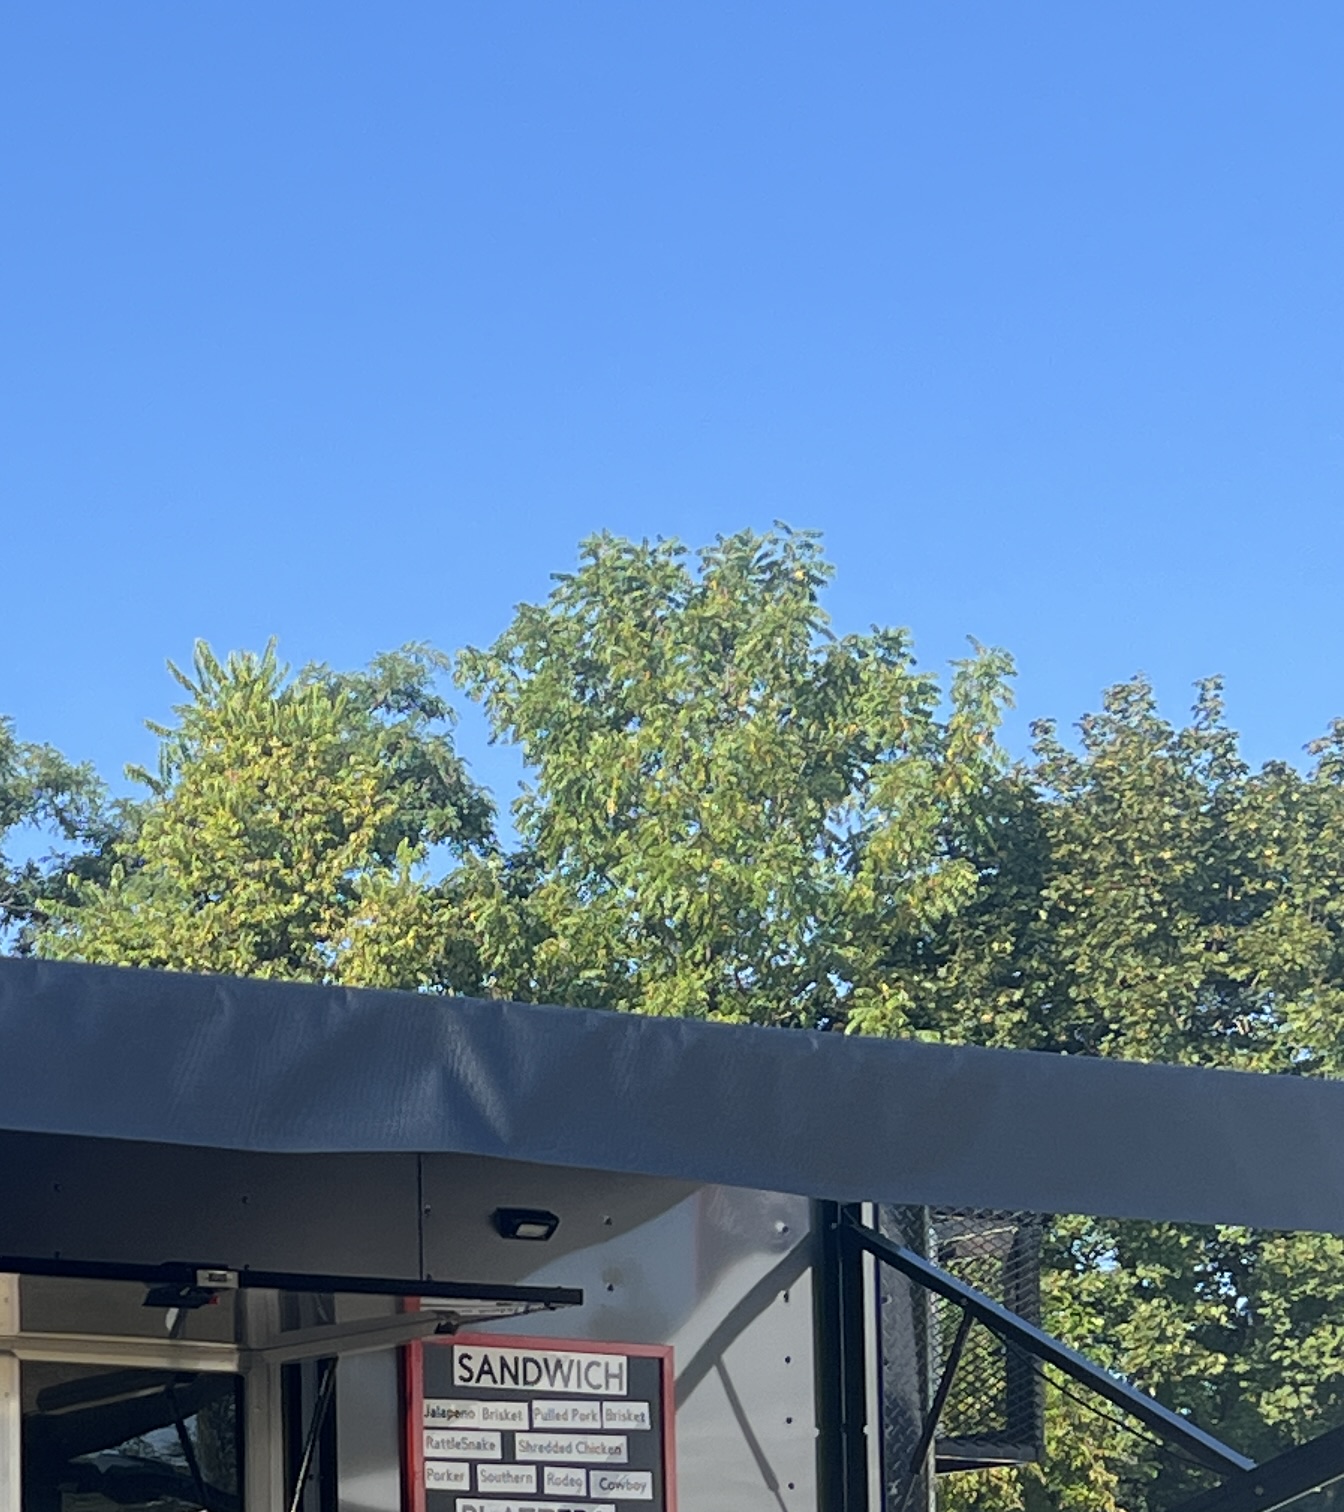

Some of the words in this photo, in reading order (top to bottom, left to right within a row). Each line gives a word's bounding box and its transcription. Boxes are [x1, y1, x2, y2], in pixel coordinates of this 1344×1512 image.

[458, 1353, 624, 1391] SANDWICH
[424, 1404, 476, 1420] Jalapeno
[482, 1407, 523, 1421] Brisket
[534, 1407, 568, 1421] Pulled
[572, 1408, 598, 1421] Pork
[605, 1409, 645, 1422] Brisket
[519, 1439, 572, 1454] Shredded
[576, 1441, 622, 1456] Chicken
[427, 1468, 464, 1482] Porker
[480, 1469, 533, 1484] Southern
[599, 1477, 647, 1495] Cowboy
